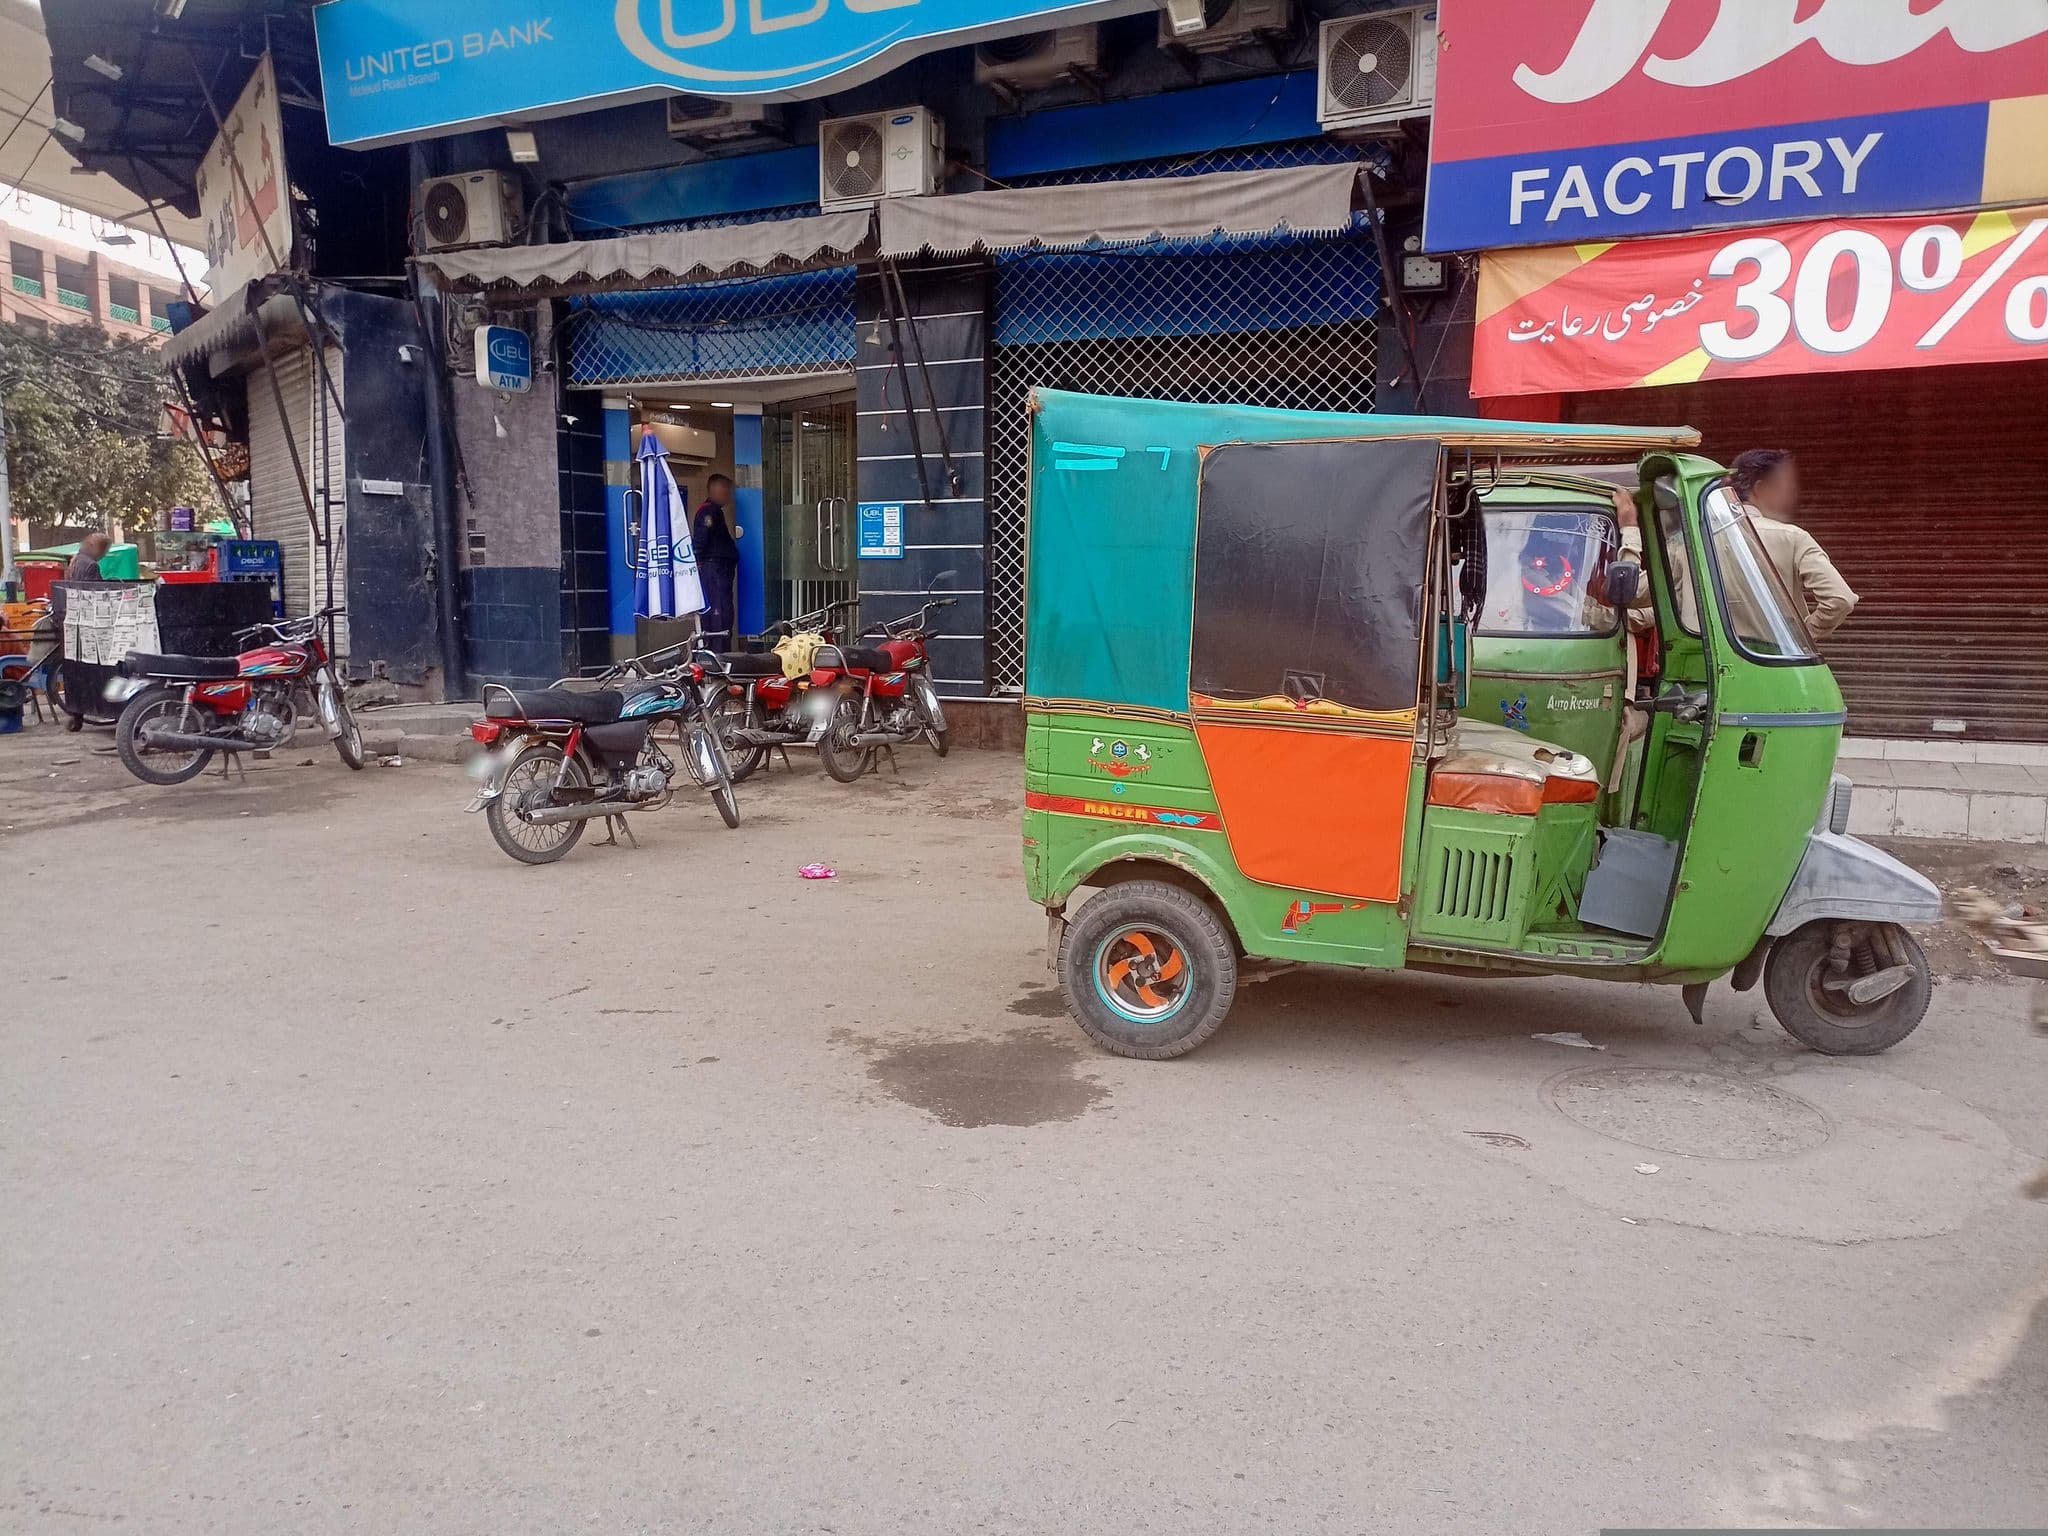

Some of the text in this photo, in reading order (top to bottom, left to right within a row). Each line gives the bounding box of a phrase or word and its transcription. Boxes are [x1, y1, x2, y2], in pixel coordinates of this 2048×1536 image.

[345, 17, 554, 81] UNITED BANK
[1508, 132, 1883, 226] FACTORY
[1507, 278, 1704, 343] خصوصی رعایت
[494, 342, 528, 361] UBL
[499, 374, 522, 389] ATM
[1547, 694, 1569, 711] AUTO
[1083, 802, 1148, 821] RACER
